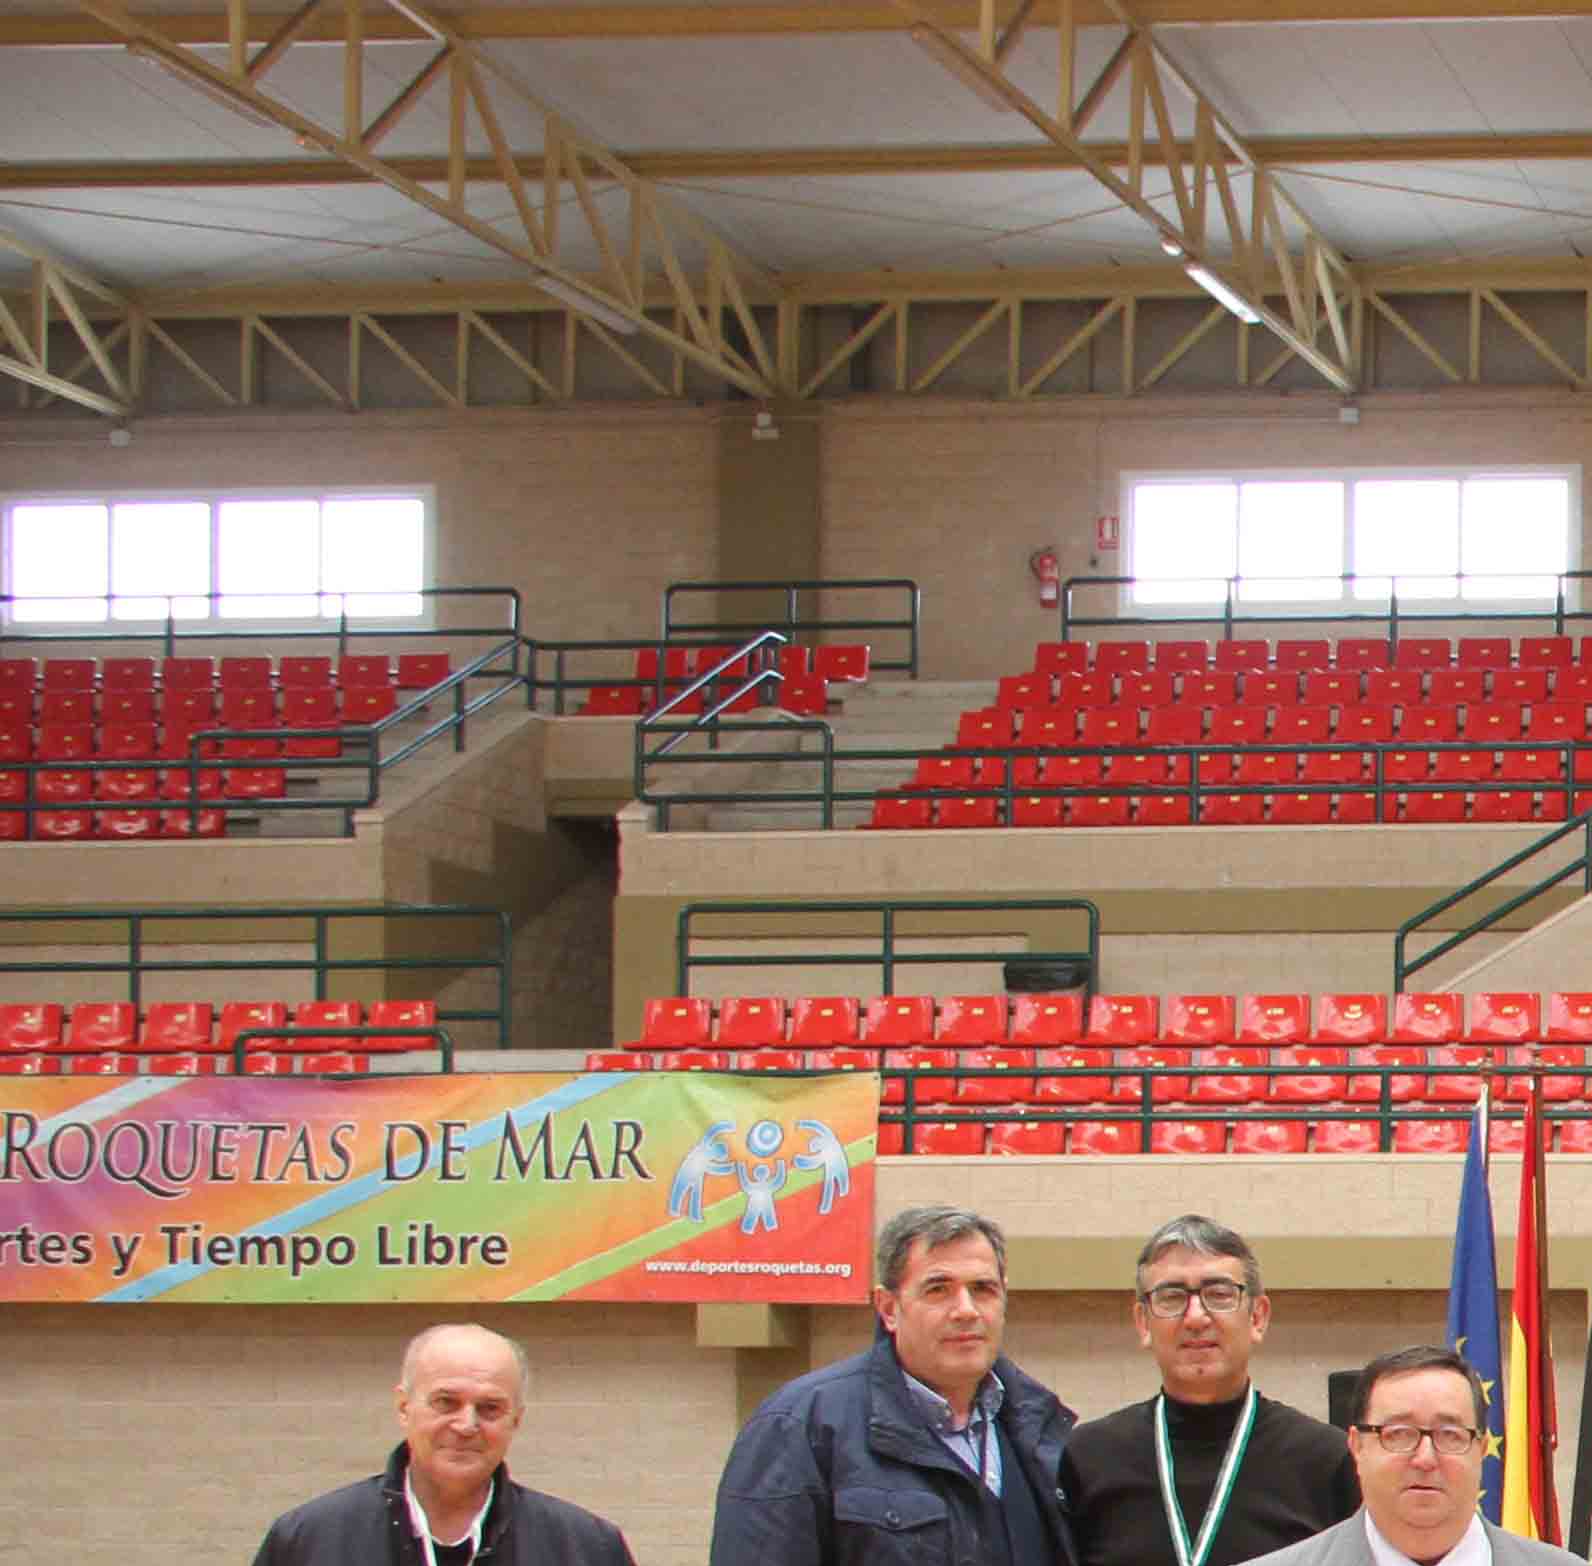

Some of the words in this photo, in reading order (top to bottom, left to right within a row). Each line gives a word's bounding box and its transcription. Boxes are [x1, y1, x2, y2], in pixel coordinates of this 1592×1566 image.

[1, 1110, 356, 1198] ROQUETAS
[383, 1120, 468, 1182] DE
[495, 1108, 655, 1183] MAR
[112, 1234, 141, 1276] y
[159, 1224, 356, 1276] Tiempo
[377, 1222, 509, 1266] Libre
[645, 1258, 852, 1278] www.deportesroquetas.org
